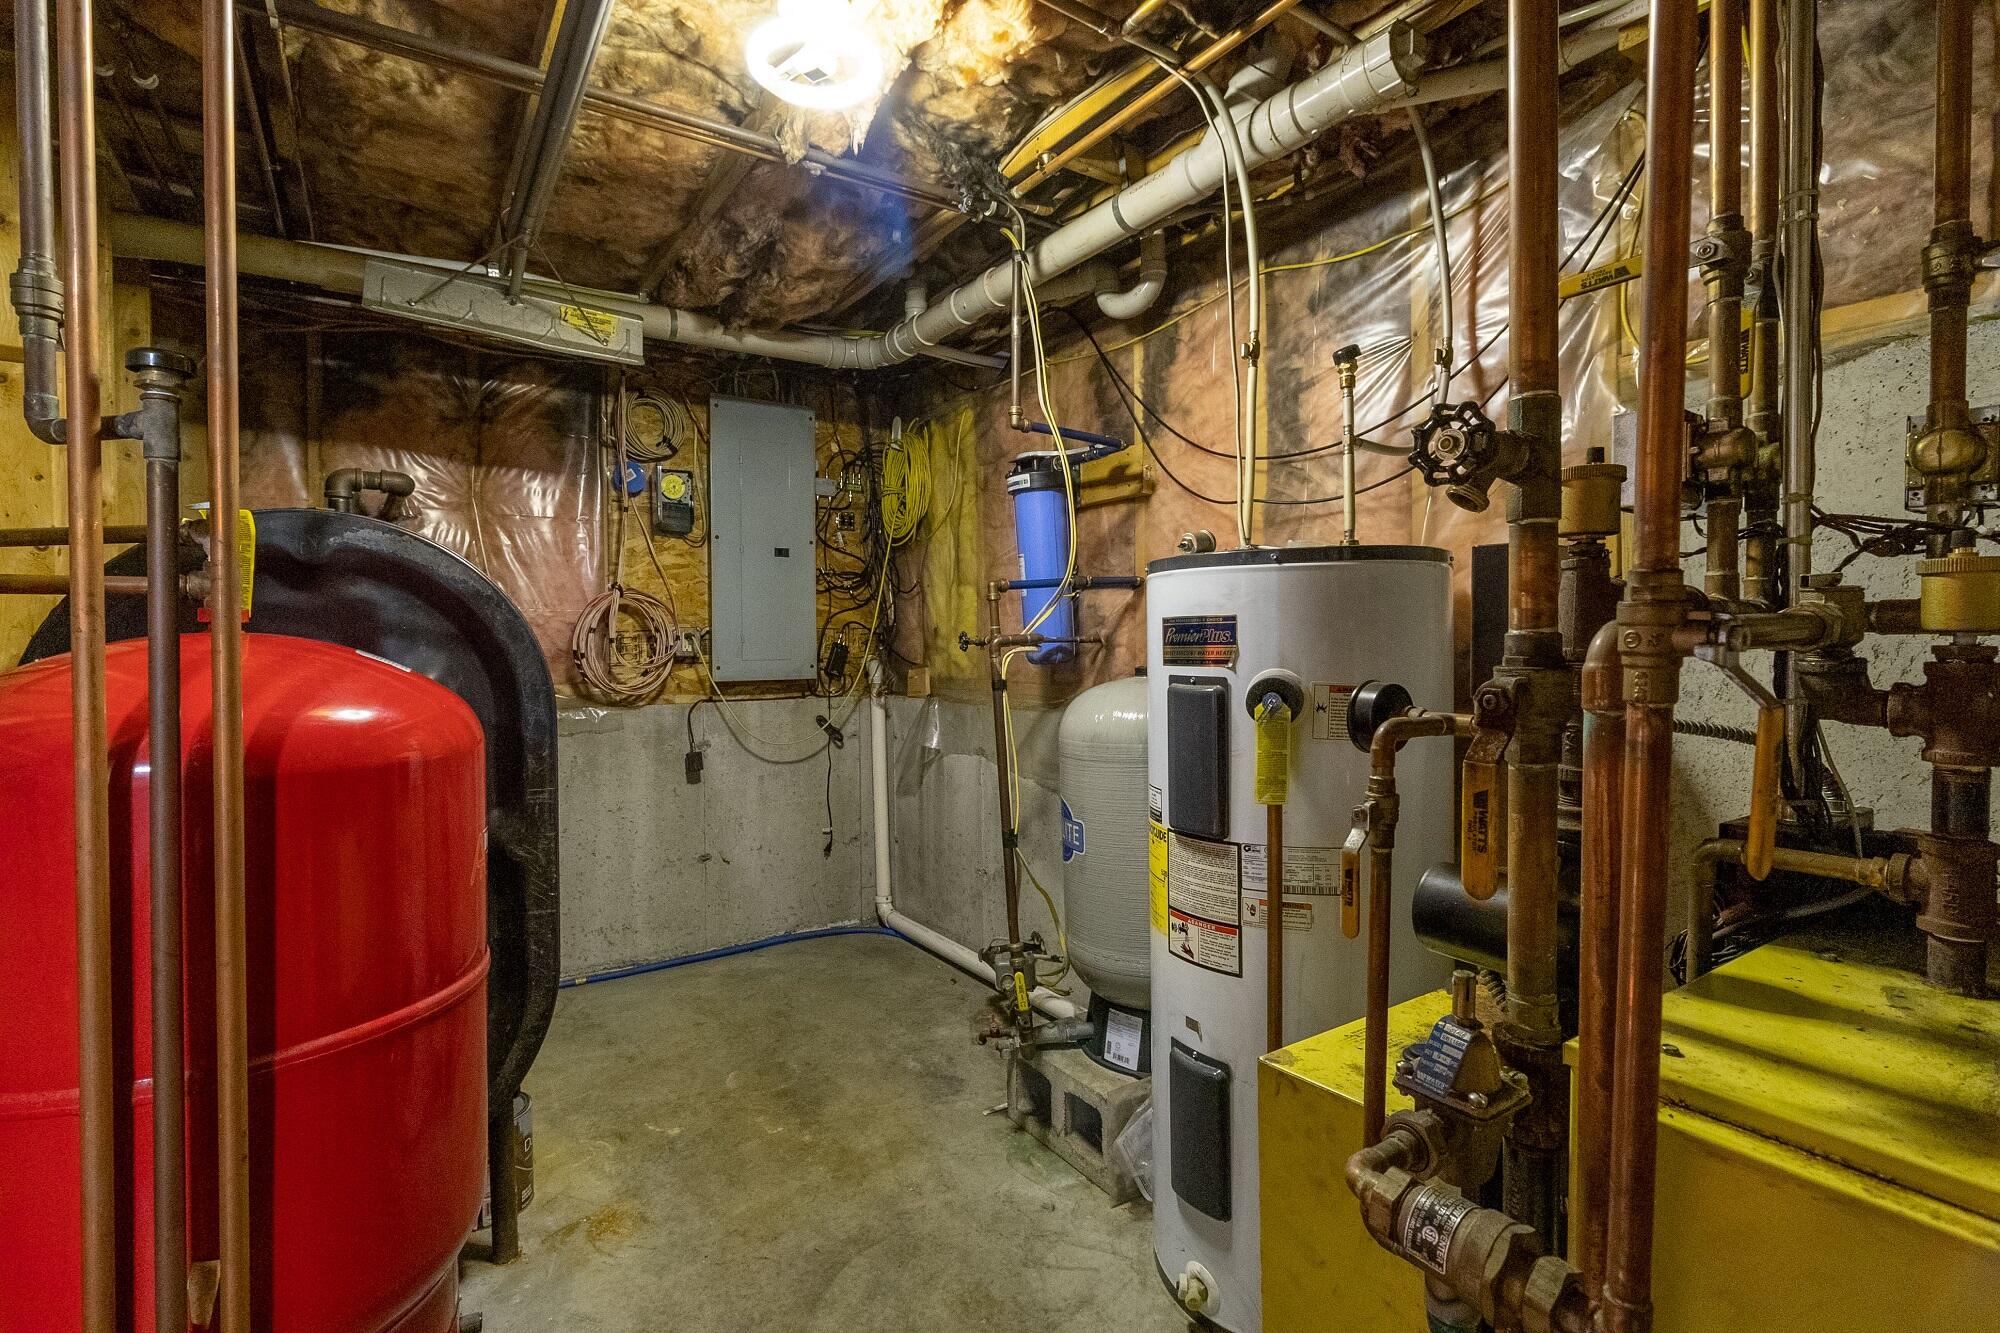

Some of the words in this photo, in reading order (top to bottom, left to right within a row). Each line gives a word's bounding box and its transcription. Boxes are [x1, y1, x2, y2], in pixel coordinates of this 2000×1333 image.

[1580, 272, 1615, 290] WATTS
[1477, 809, 1489, 854] WATTS
[1191, 918, 1216, 931] DANGER
[1435, 1214, 1457, 1264] PREVENTER
